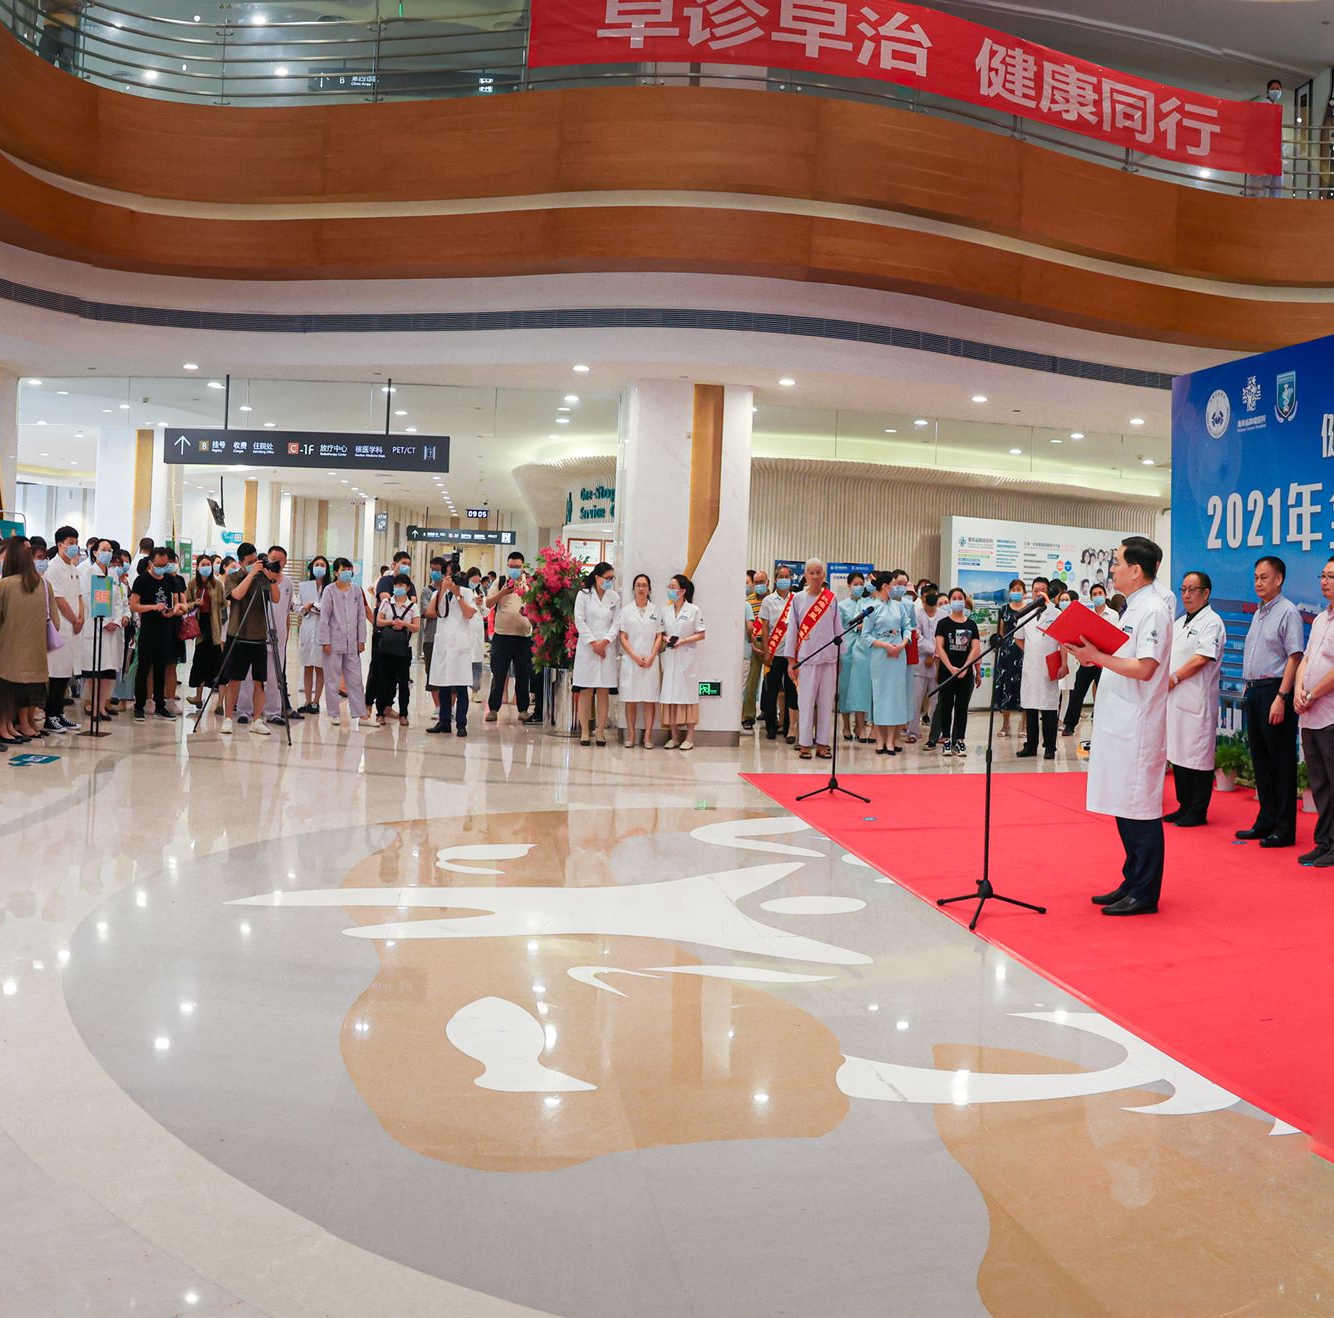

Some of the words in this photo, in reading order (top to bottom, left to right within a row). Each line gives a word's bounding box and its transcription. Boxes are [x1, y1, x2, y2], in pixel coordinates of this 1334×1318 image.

[596, 0, 933, 77] 早诊早治
[975, 37, 1221, 156] 健康同行
[392, 446, 416, 455] PET/CT
